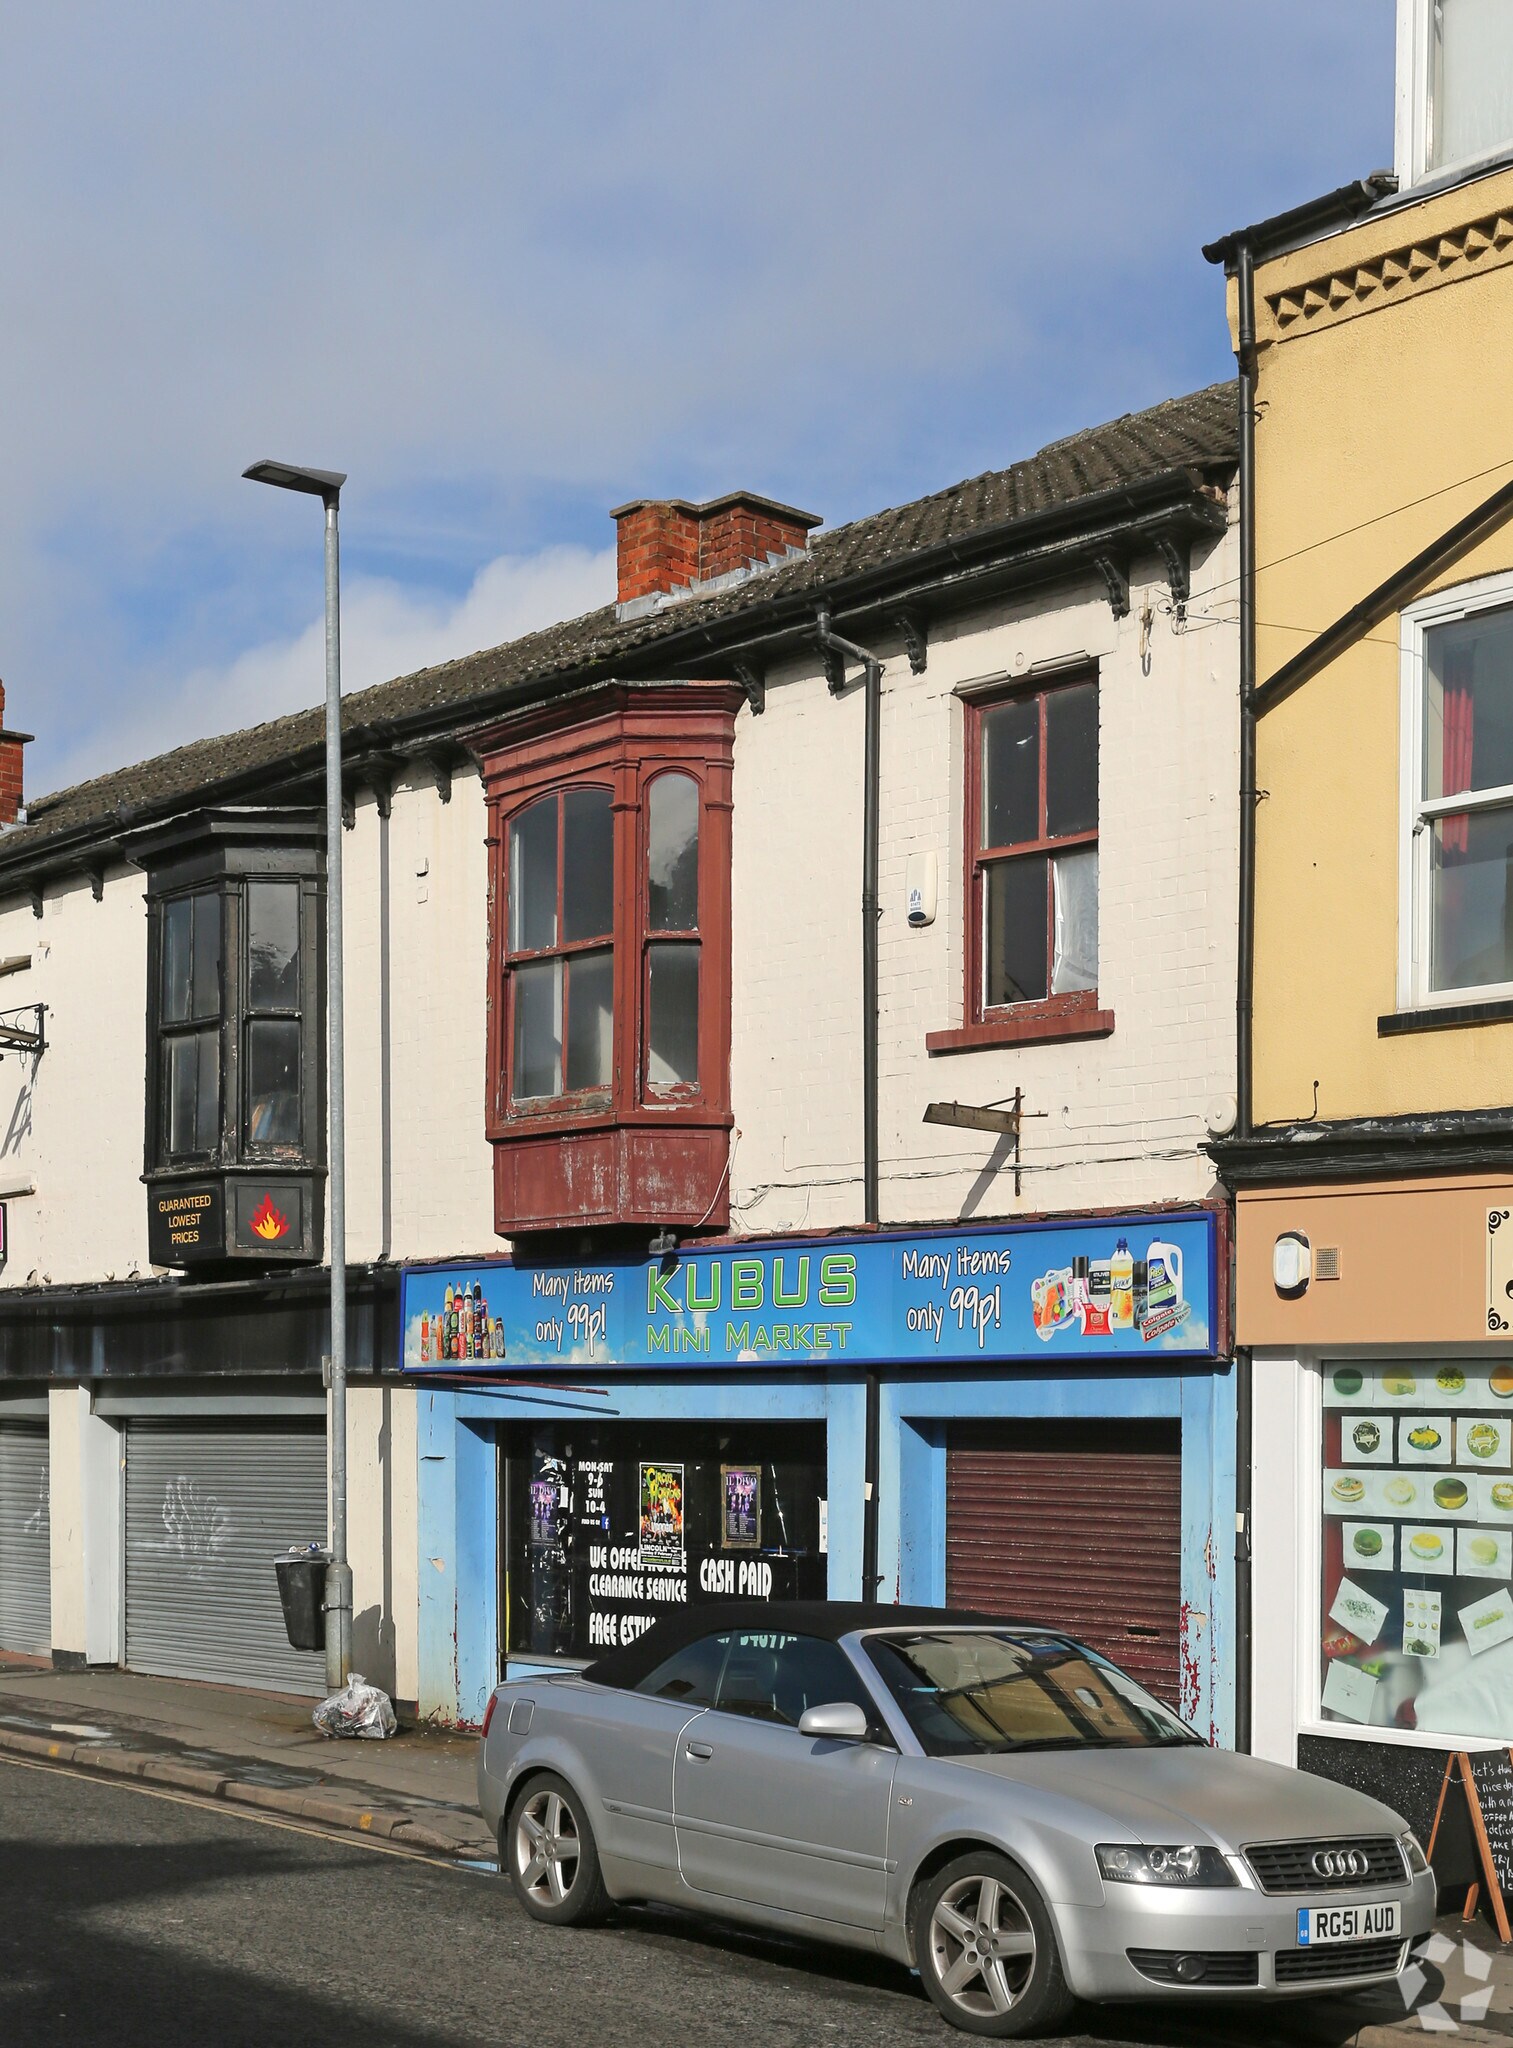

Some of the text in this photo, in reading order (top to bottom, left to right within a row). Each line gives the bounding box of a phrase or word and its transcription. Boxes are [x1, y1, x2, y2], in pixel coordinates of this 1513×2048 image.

[159, 1195, 211, 1212] GUARANTEED
[168, 1213, 201, 1228] LOWEST
[171, 1231, 199, 1245] PRICES
[902, 1246, 1011, 1290] Many items
[532, 1269, 614, 1307] Many items
[647, 1254, 857, 1314] KUBUS
[907, 1284, 1001, 1349] only 99p!
[1143, 1308, 1172, 1326] Colgate
[536, 1316, 563, 1352] only
[567, 1302, 606, 1357] 99p!
[726, 1322, 852, 1351] MARKET
[1146, 1319, 1175, 1339] Colgate
[578, 1461, 614, 1472] MON-SAT
[588, 1472, 604, 1487] 9-6
[726, 1477, 757, 1486] IL DIVO
[530, 1486, 557, 1495] IL DIVO
[588, 1488, 603, 1499] SUN
[585, 1500, 606, 1514] 10-4
[589, 1546, 607, 1569] WE
[641, 1544, 668, 1553] LINCOLN
[700, 1558, 734, 1594] CASH
[738, 1561, 773, 1597] PAID
[589, 1574, 687, 1602] CLEARANCE SERVICE
[589, 1612, 617, 1646] FREE
[1316, 1907, 1394, 1938] RG51 AUD
